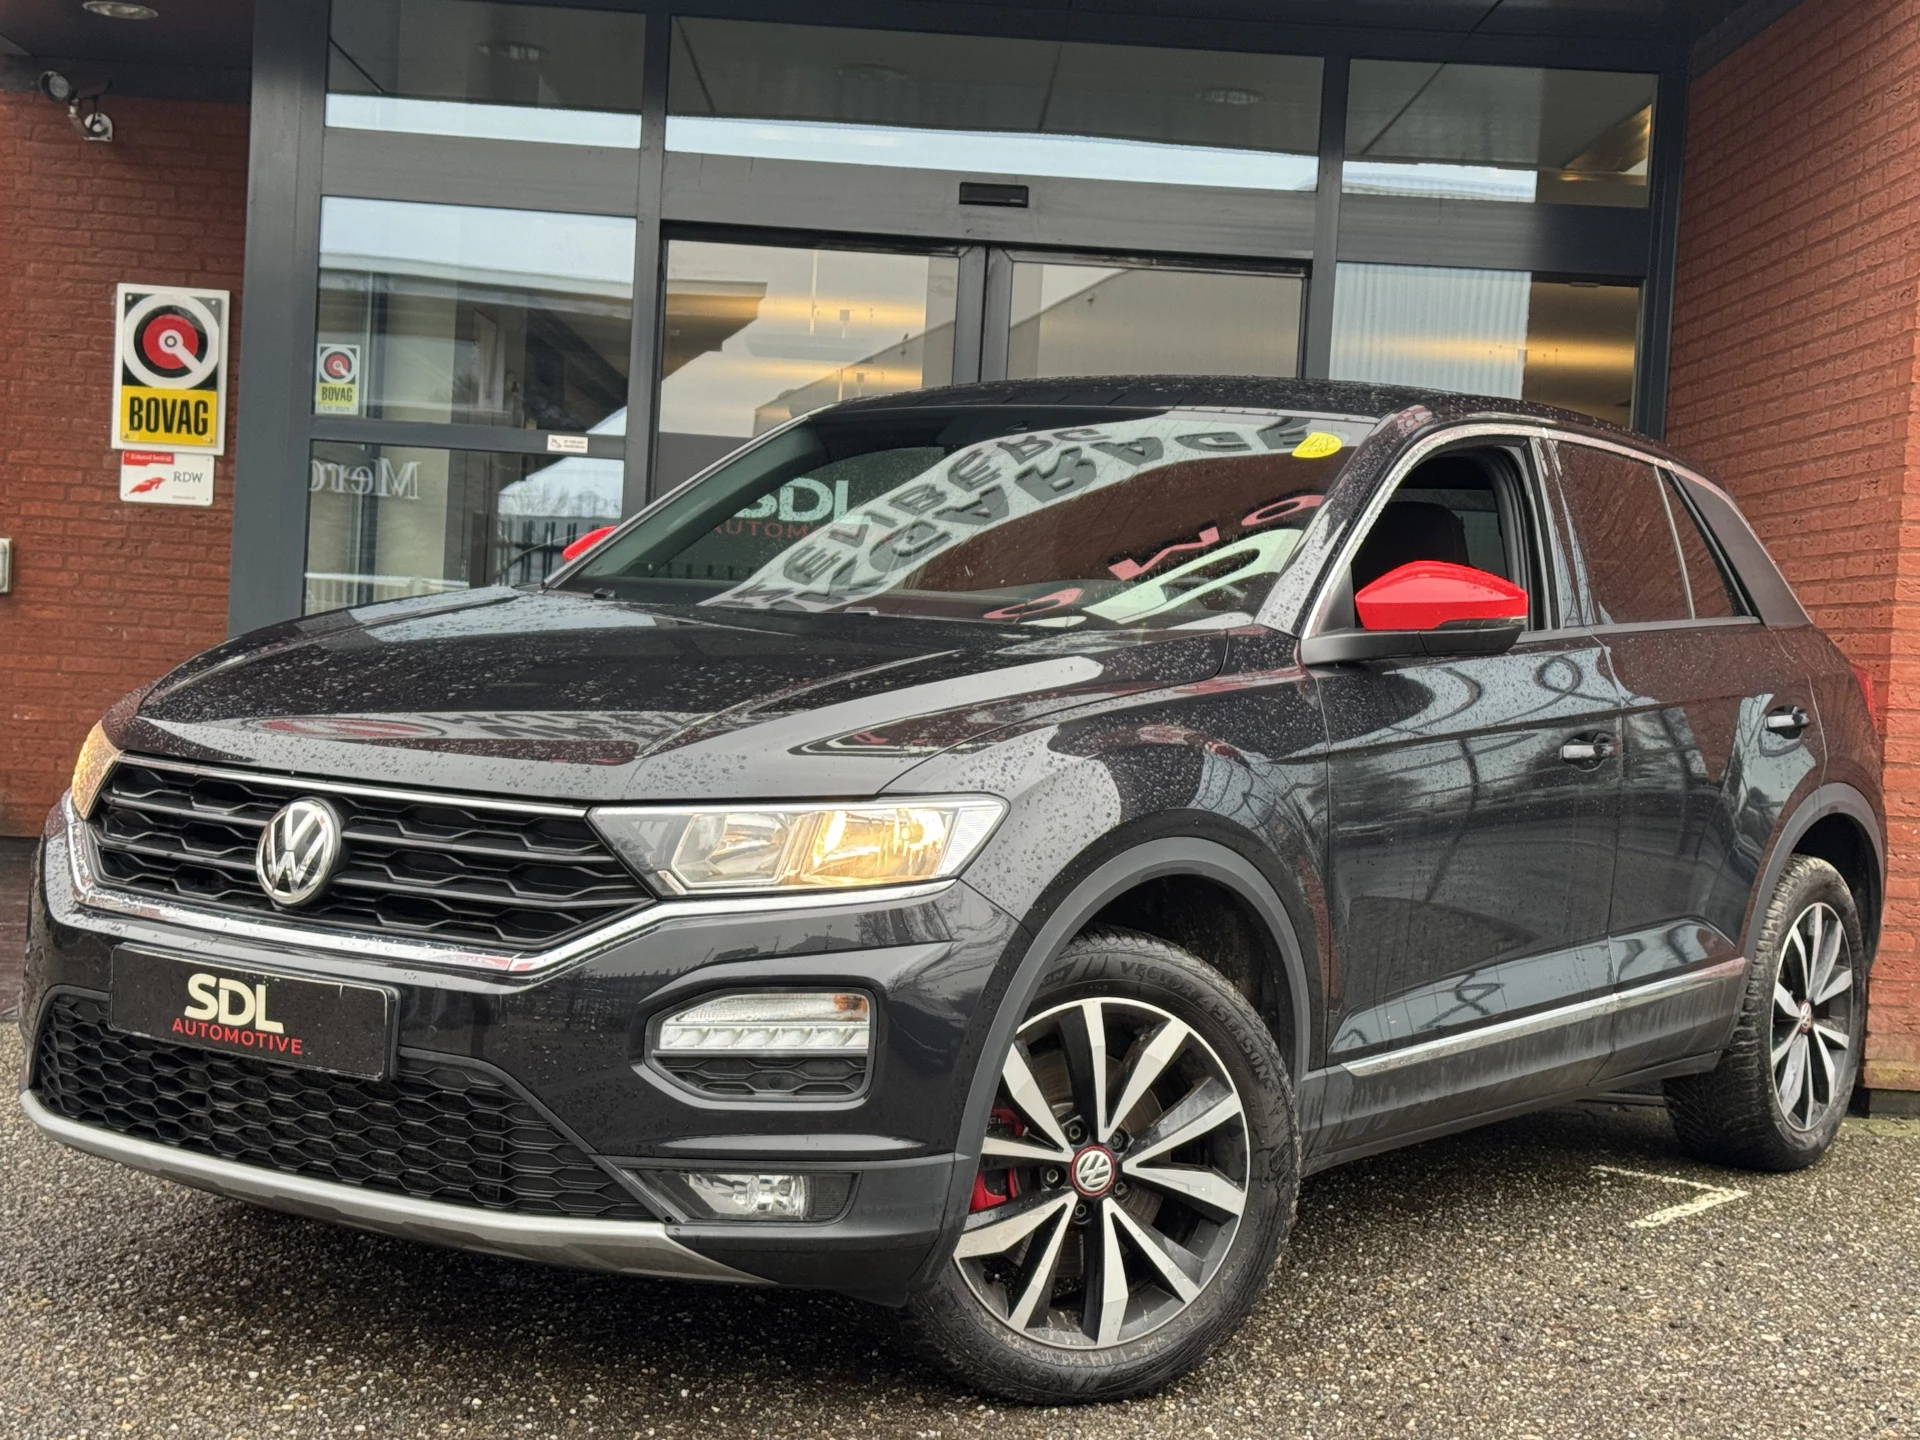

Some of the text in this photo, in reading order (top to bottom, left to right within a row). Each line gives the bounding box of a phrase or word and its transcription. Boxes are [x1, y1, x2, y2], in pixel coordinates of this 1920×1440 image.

[321, 386, 353, 402] BOVAG
[129, 396, 209, 436] BOVAG
[173, 470, 203, 484] RDW
[184, 973, 285, 1035] SDL
[171, 1017, 303, 1056] AUTOMOTIVE
